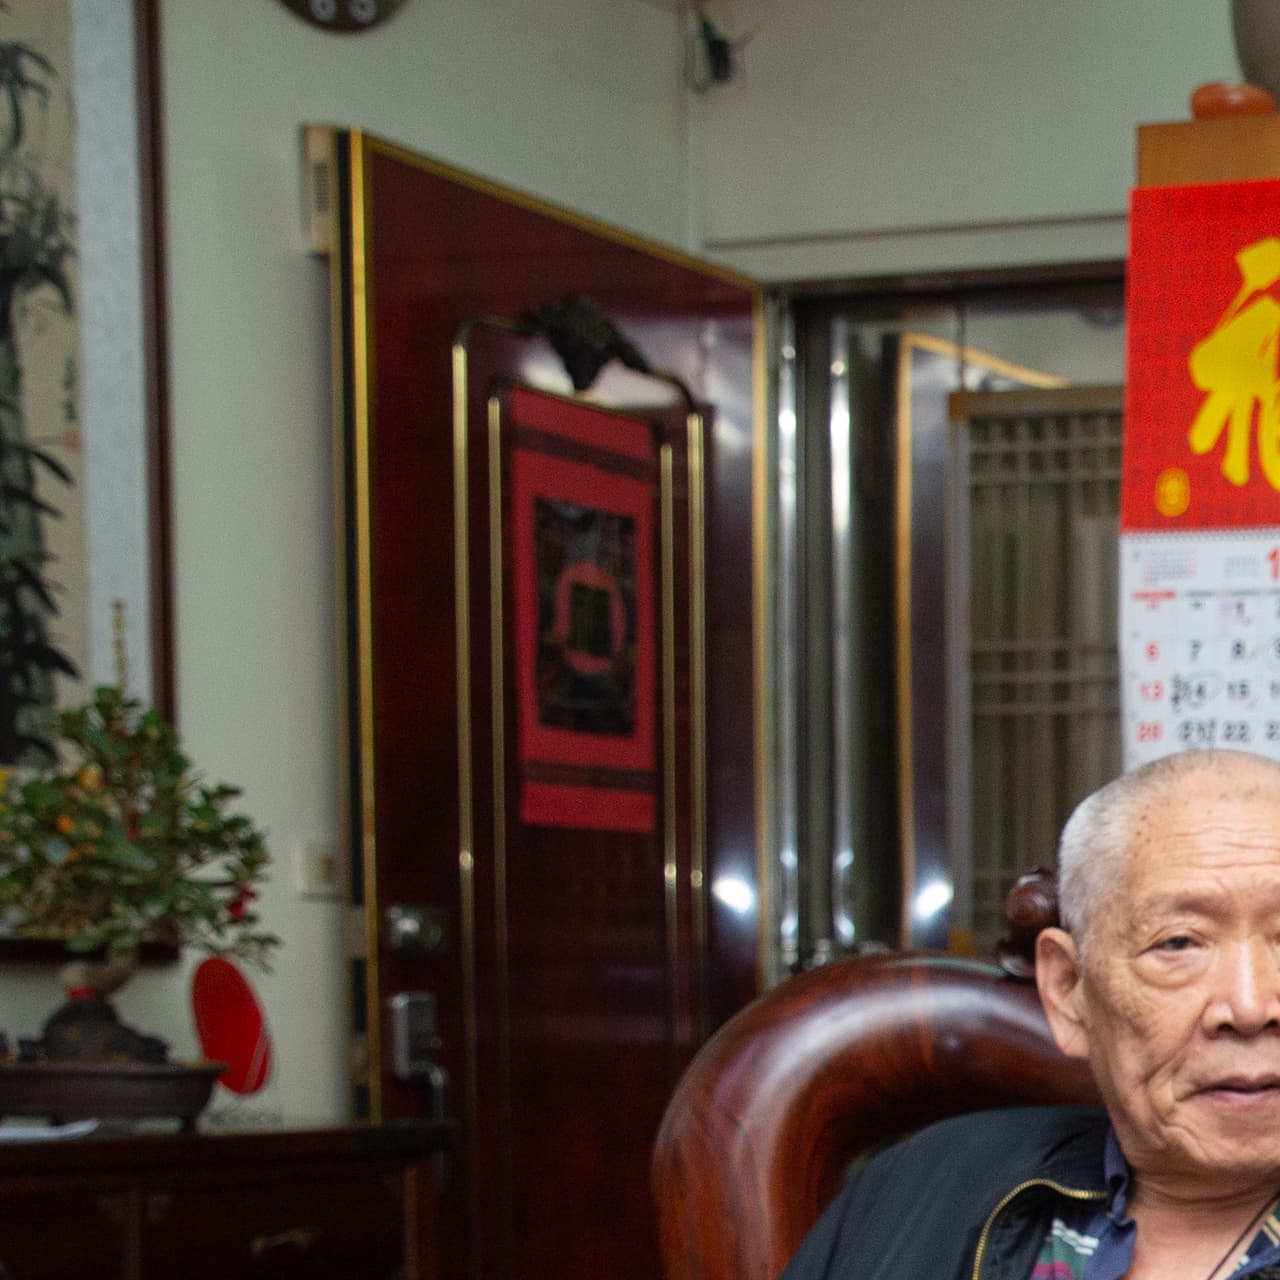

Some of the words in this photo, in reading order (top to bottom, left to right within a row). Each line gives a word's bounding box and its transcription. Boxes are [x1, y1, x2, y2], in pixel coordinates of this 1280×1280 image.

[1235, 599, 1246, 618] 1
[1144, 640, 1160, 663] 6
[1188, 638, 1203, 662] 7
[1231, 637, 1246, 660] 8
[1139, 680, 1164, 702] 13
[1227, 679, 1249, 701] 15
[1137, 720, 1164, 743] 20
[1223, 719, 1250, 742] 22
